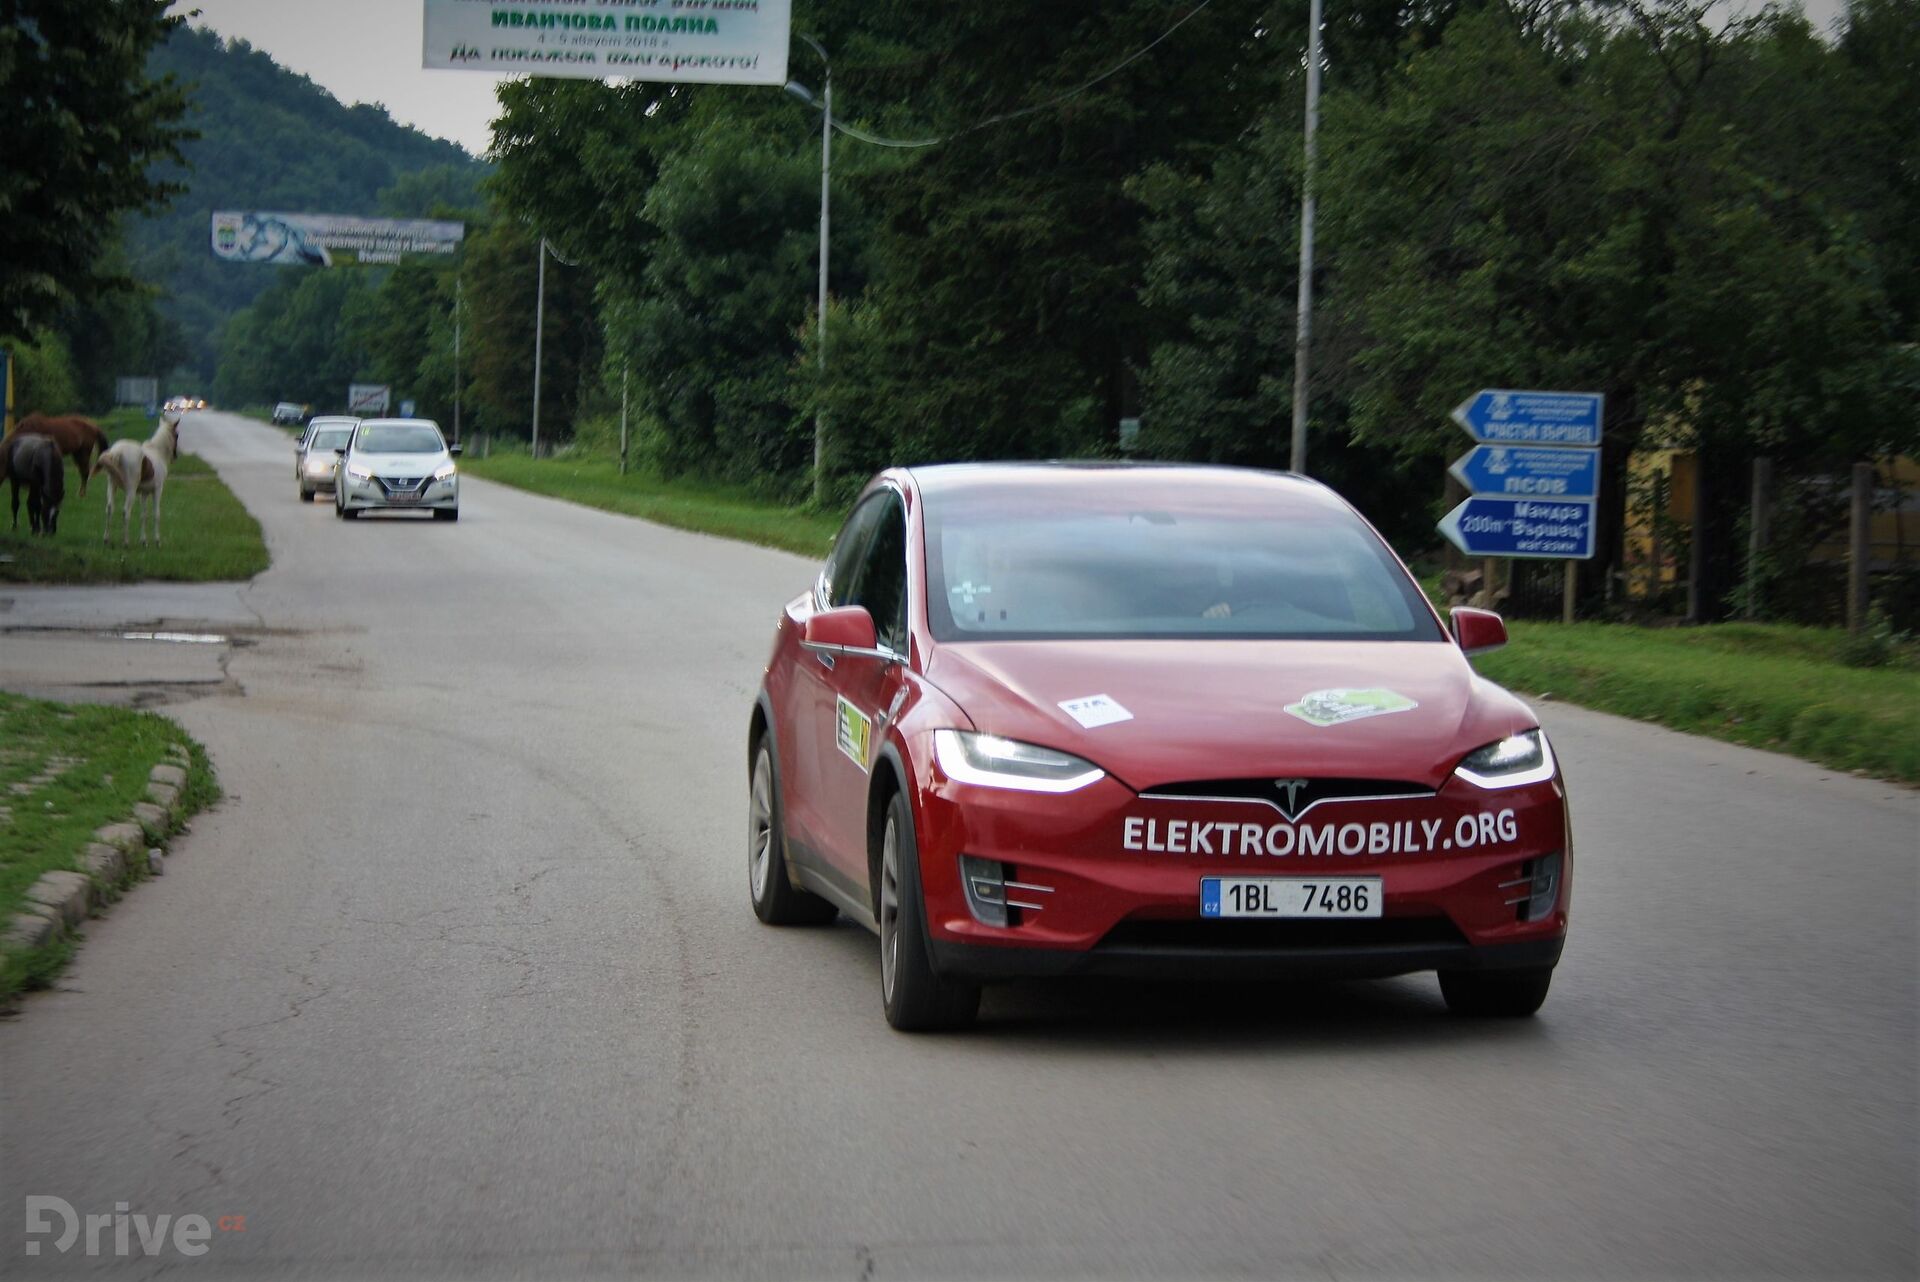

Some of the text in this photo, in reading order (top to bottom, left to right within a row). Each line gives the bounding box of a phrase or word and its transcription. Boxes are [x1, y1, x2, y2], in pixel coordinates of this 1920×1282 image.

[491, 10, 718, 34] ИВАНЧОВА ПОЛЯНА
[625, 35, 657, 48] 2018
[450, 42, 759, 71] Да покажем българското!
[1504, 476, 1568, 494] ПСОВ
[1514, 502, 1583, 521] Мандра
[1123, 808, 1518, 856] ELEKTROMOBILY.ORG
[1230, 885, 1278, 912] 1BL
[1302, 885, 1369, 912] 7486
